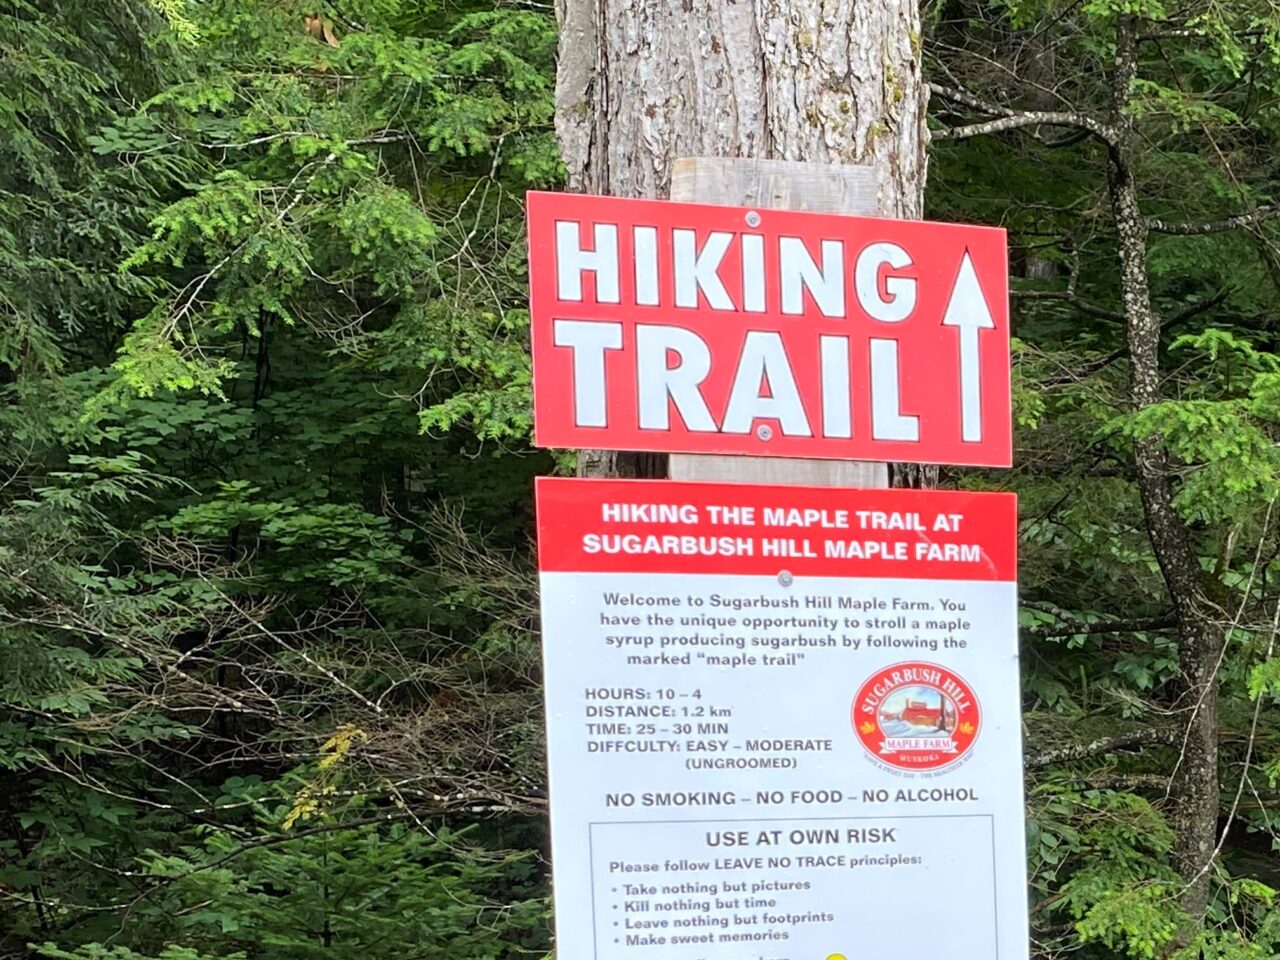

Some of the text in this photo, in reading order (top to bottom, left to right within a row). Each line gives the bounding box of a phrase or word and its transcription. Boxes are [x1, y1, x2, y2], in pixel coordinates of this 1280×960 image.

[557, 222, 916, 321] HIKING
[554, 320, 918, 441] TRAIL
[603, 504, 963, 531] HIKING THE MAPLE TRAIL AT
[583, 534, 980, 562] SUGARBUSH HILL MAPLE FARM
[604, 593, 965, 612] Welcome to Sugarbush Hill Maple Farm. You
[600, 613, 970, 632] have the unique opportunity to stroll a maple
[606, 633, 967, 651] syrup producing sugarbush by following the
[628, 652, 690, 664] marked
[585, 688, 701, 699] HOURS: 10 4
[862, 668, 971, 714] SUGARBUSH HILL
[586, 706, 731, 717] DISTANCE: 1.2 km
[586, 723, 728, 734] TIME: 25 30 MIN
[588, 740, 832, 752] DIFFCULTY: EASY MODERATE
[887, 740, 951, 748] MAPLE FARM
[686, 758, 796, 770] (UNGROOMED)
[606, 789, 978, 806] NO SMOKING NO FOOD NO ALCOHOL
[707, 828, 895, 846] USE AT OWN RISK
[610, 854, 921, 872] Please follow LEAVE NO TRACE principles:
[623, 880, 810, 895] Take nothing but pictures
[625, 897, 776, 912] Kill nothing but time
[625, 912, 834, 929] Leave nothing but footprints
[626, 929, 789, 945] Make sweet memories
